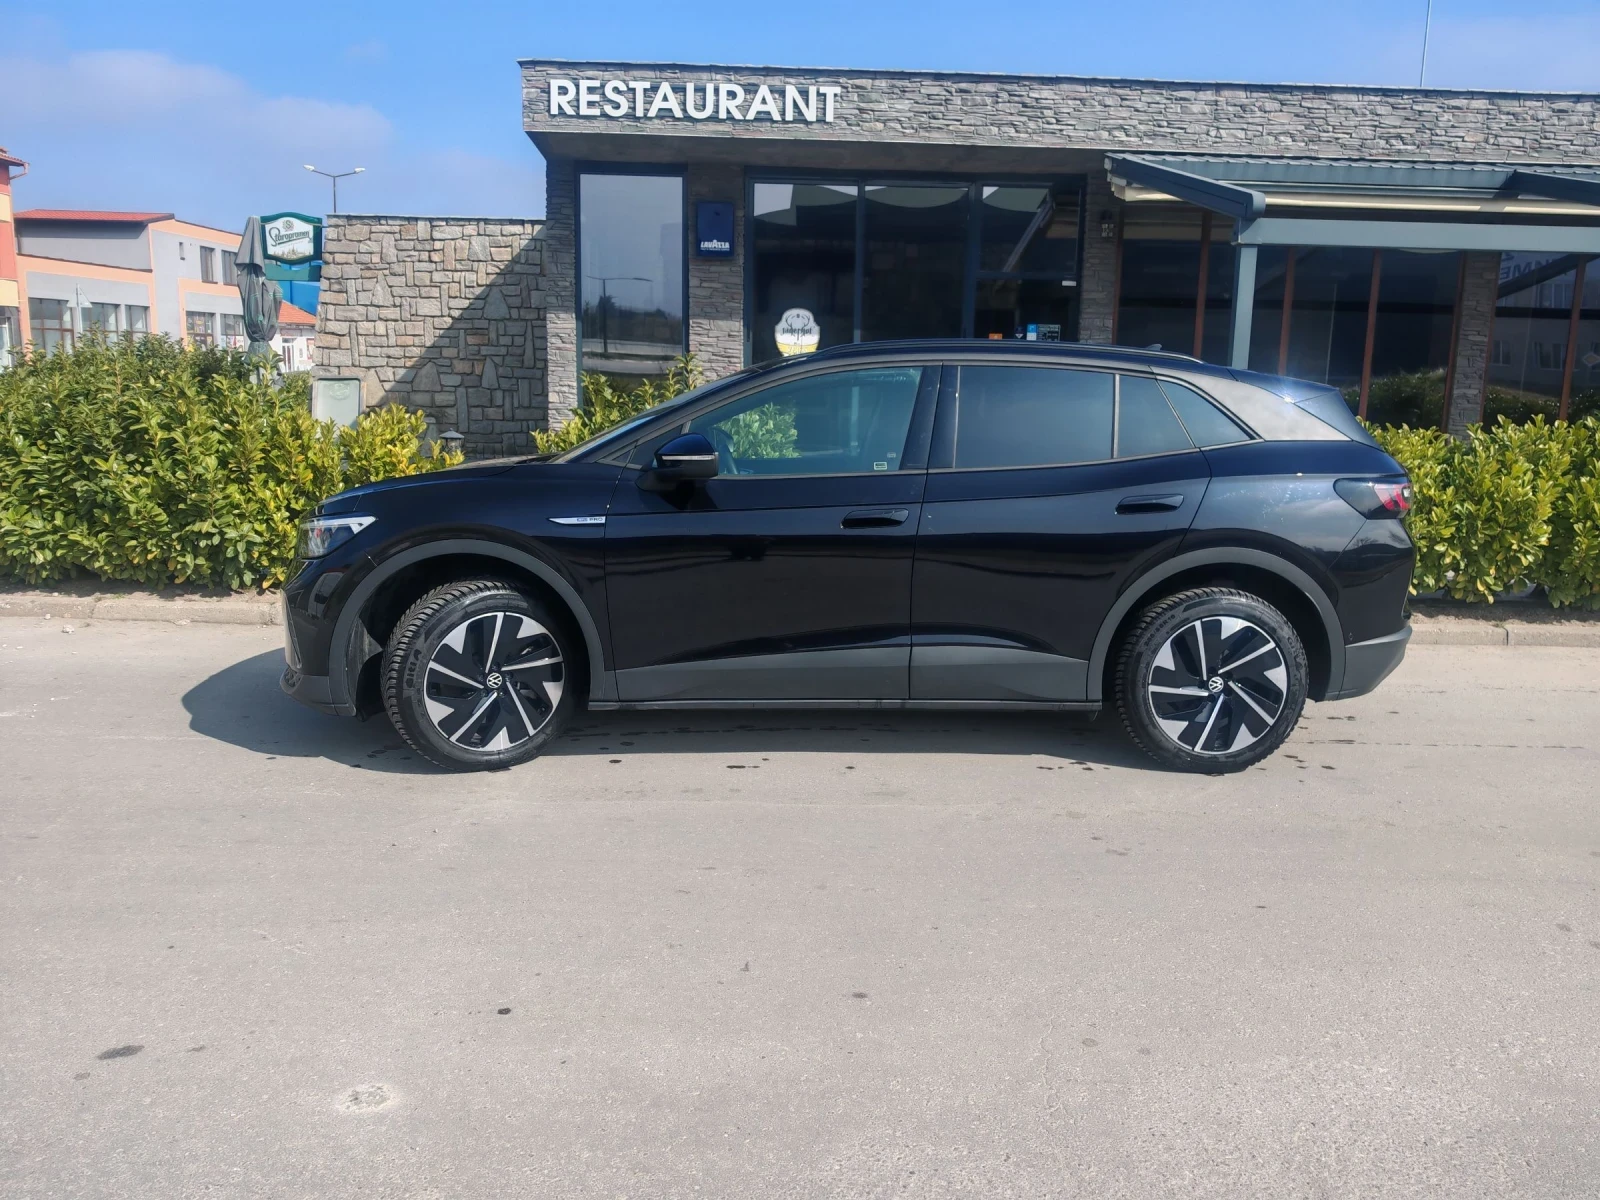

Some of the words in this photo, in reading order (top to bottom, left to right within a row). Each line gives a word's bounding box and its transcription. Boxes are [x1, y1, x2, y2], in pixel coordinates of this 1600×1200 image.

[550, 79, 841, 122] RESTAURANT
[268, 226, 312, 247] Staropramen
[700, 239, 730, 249] LAVAZZA
